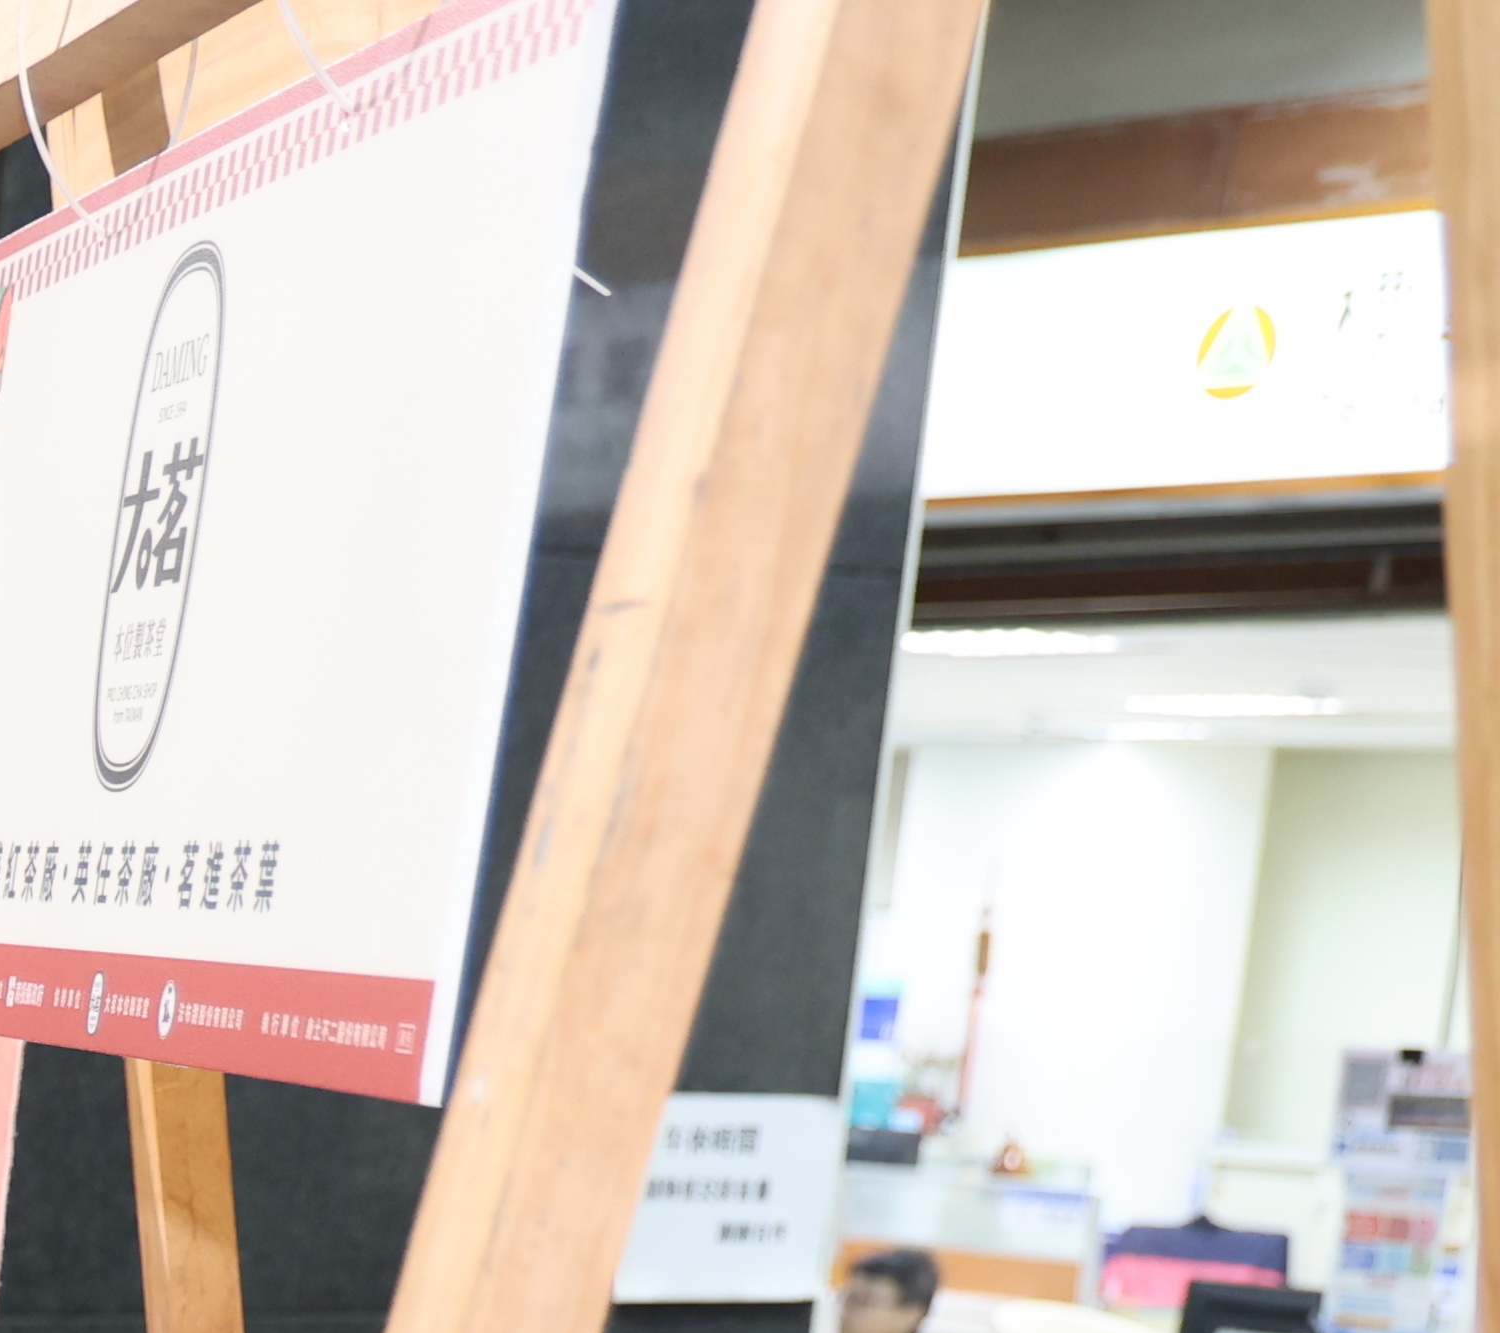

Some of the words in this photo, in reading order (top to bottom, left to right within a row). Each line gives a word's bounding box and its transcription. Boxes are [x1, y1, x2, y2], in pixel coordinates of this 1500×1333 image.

[151, 334, 211, 394] DAMING
[111, 436, 205, 593] 大茗
[113, 617, 167, 664] 本位製茶堂
